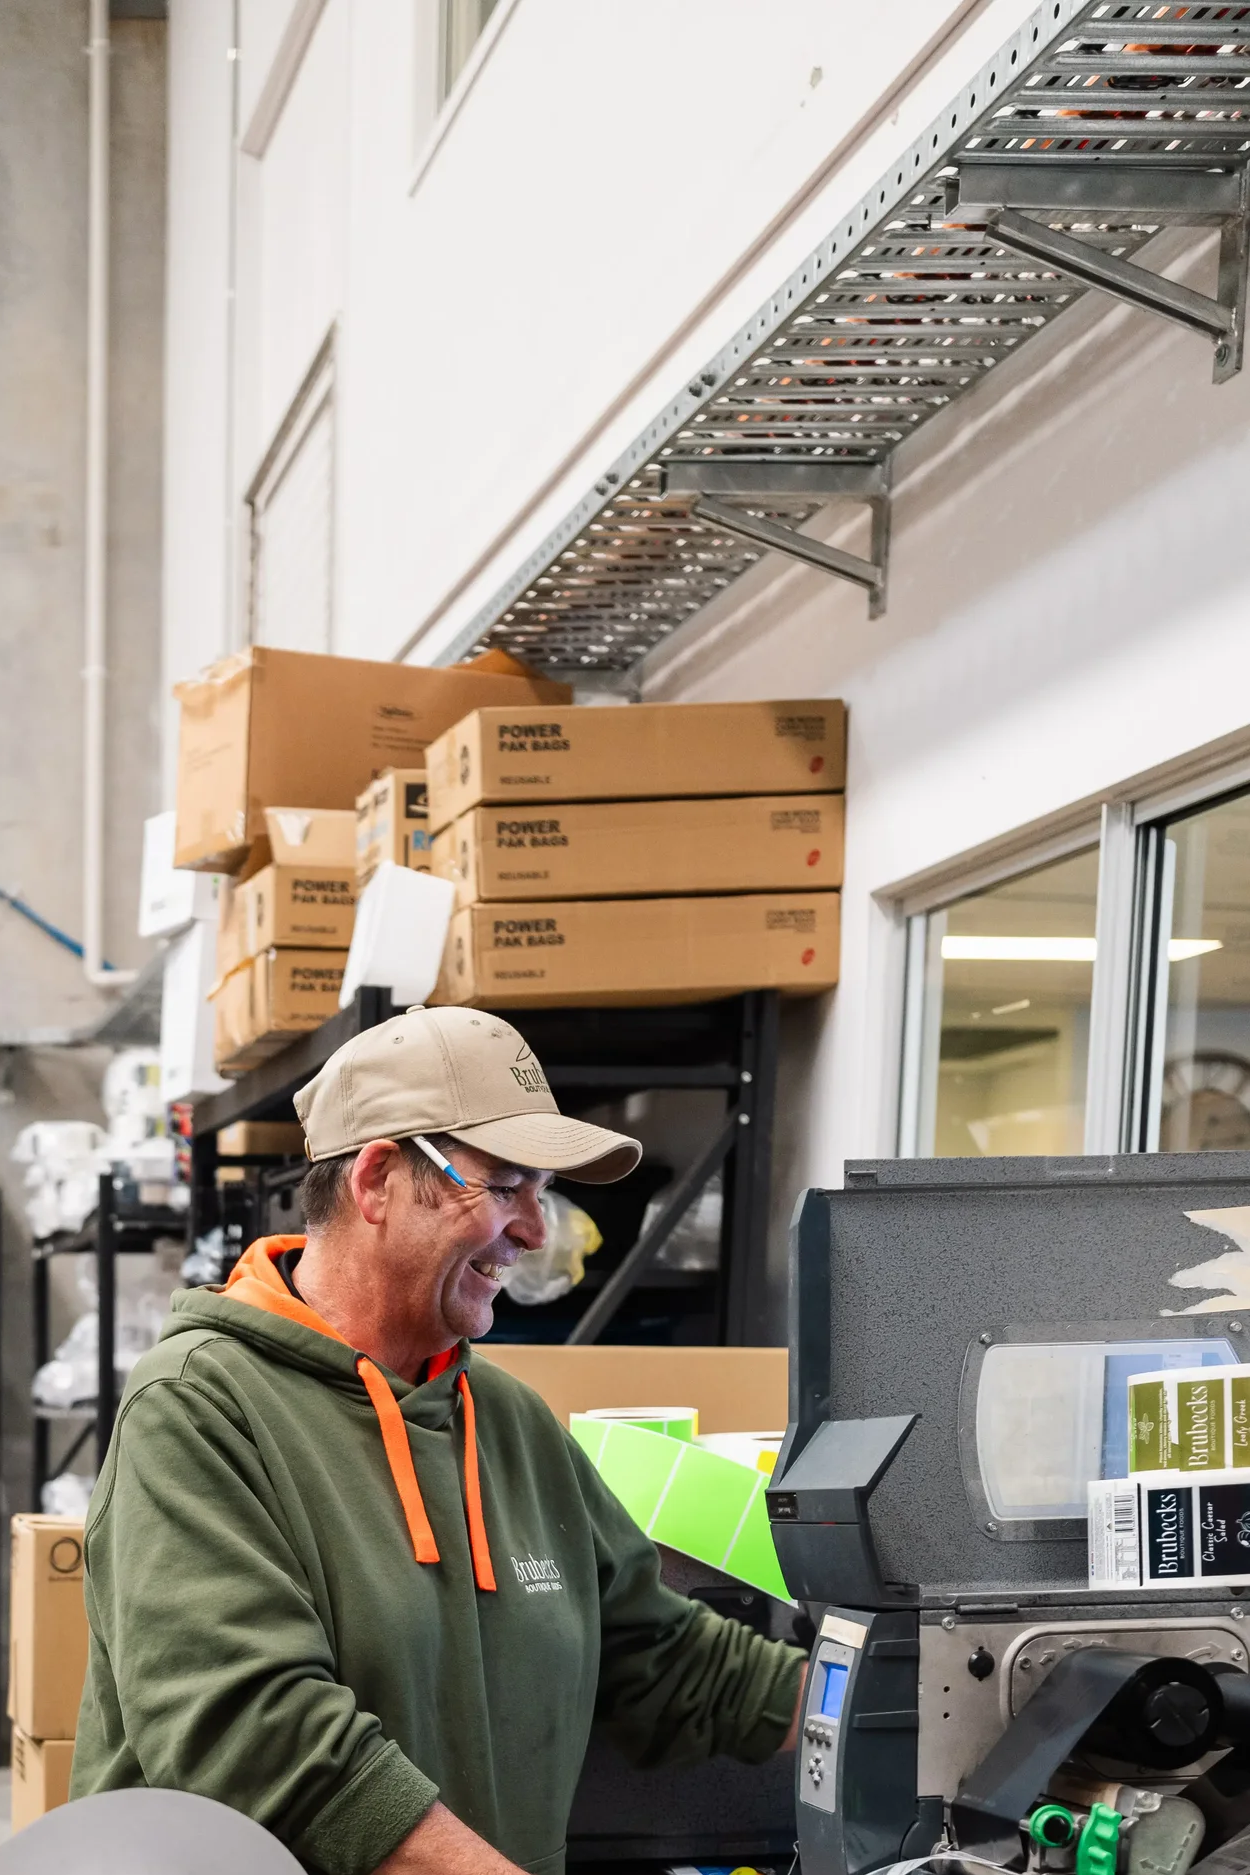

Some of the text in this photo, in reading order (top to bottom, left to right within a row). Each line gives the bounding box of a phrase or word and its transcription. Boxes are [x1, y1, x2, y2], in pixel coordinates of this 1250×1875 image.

[498, 723, 562, 740] POWER
[498, 738, 570, 752] PAK BAGS
[496, 820, 561, 836] POWER
[496, 835, 568, 848] PAK BAGS
[292, 879, 350, 893] POWER
[493, 918, 557, 935] POWER
[493, 934, 565, 948] PAK BAGS
[1186, 1385, 1209, 1466] Brubecks
[1234, 1399, 1250, 1447] Leafy Greek
[1156, 1493, 1179, 1574] Brubecks
[1202, 1502, 1215, 1562] Classic Caesar
[1214, 1519, 1227, 1542] Salad
